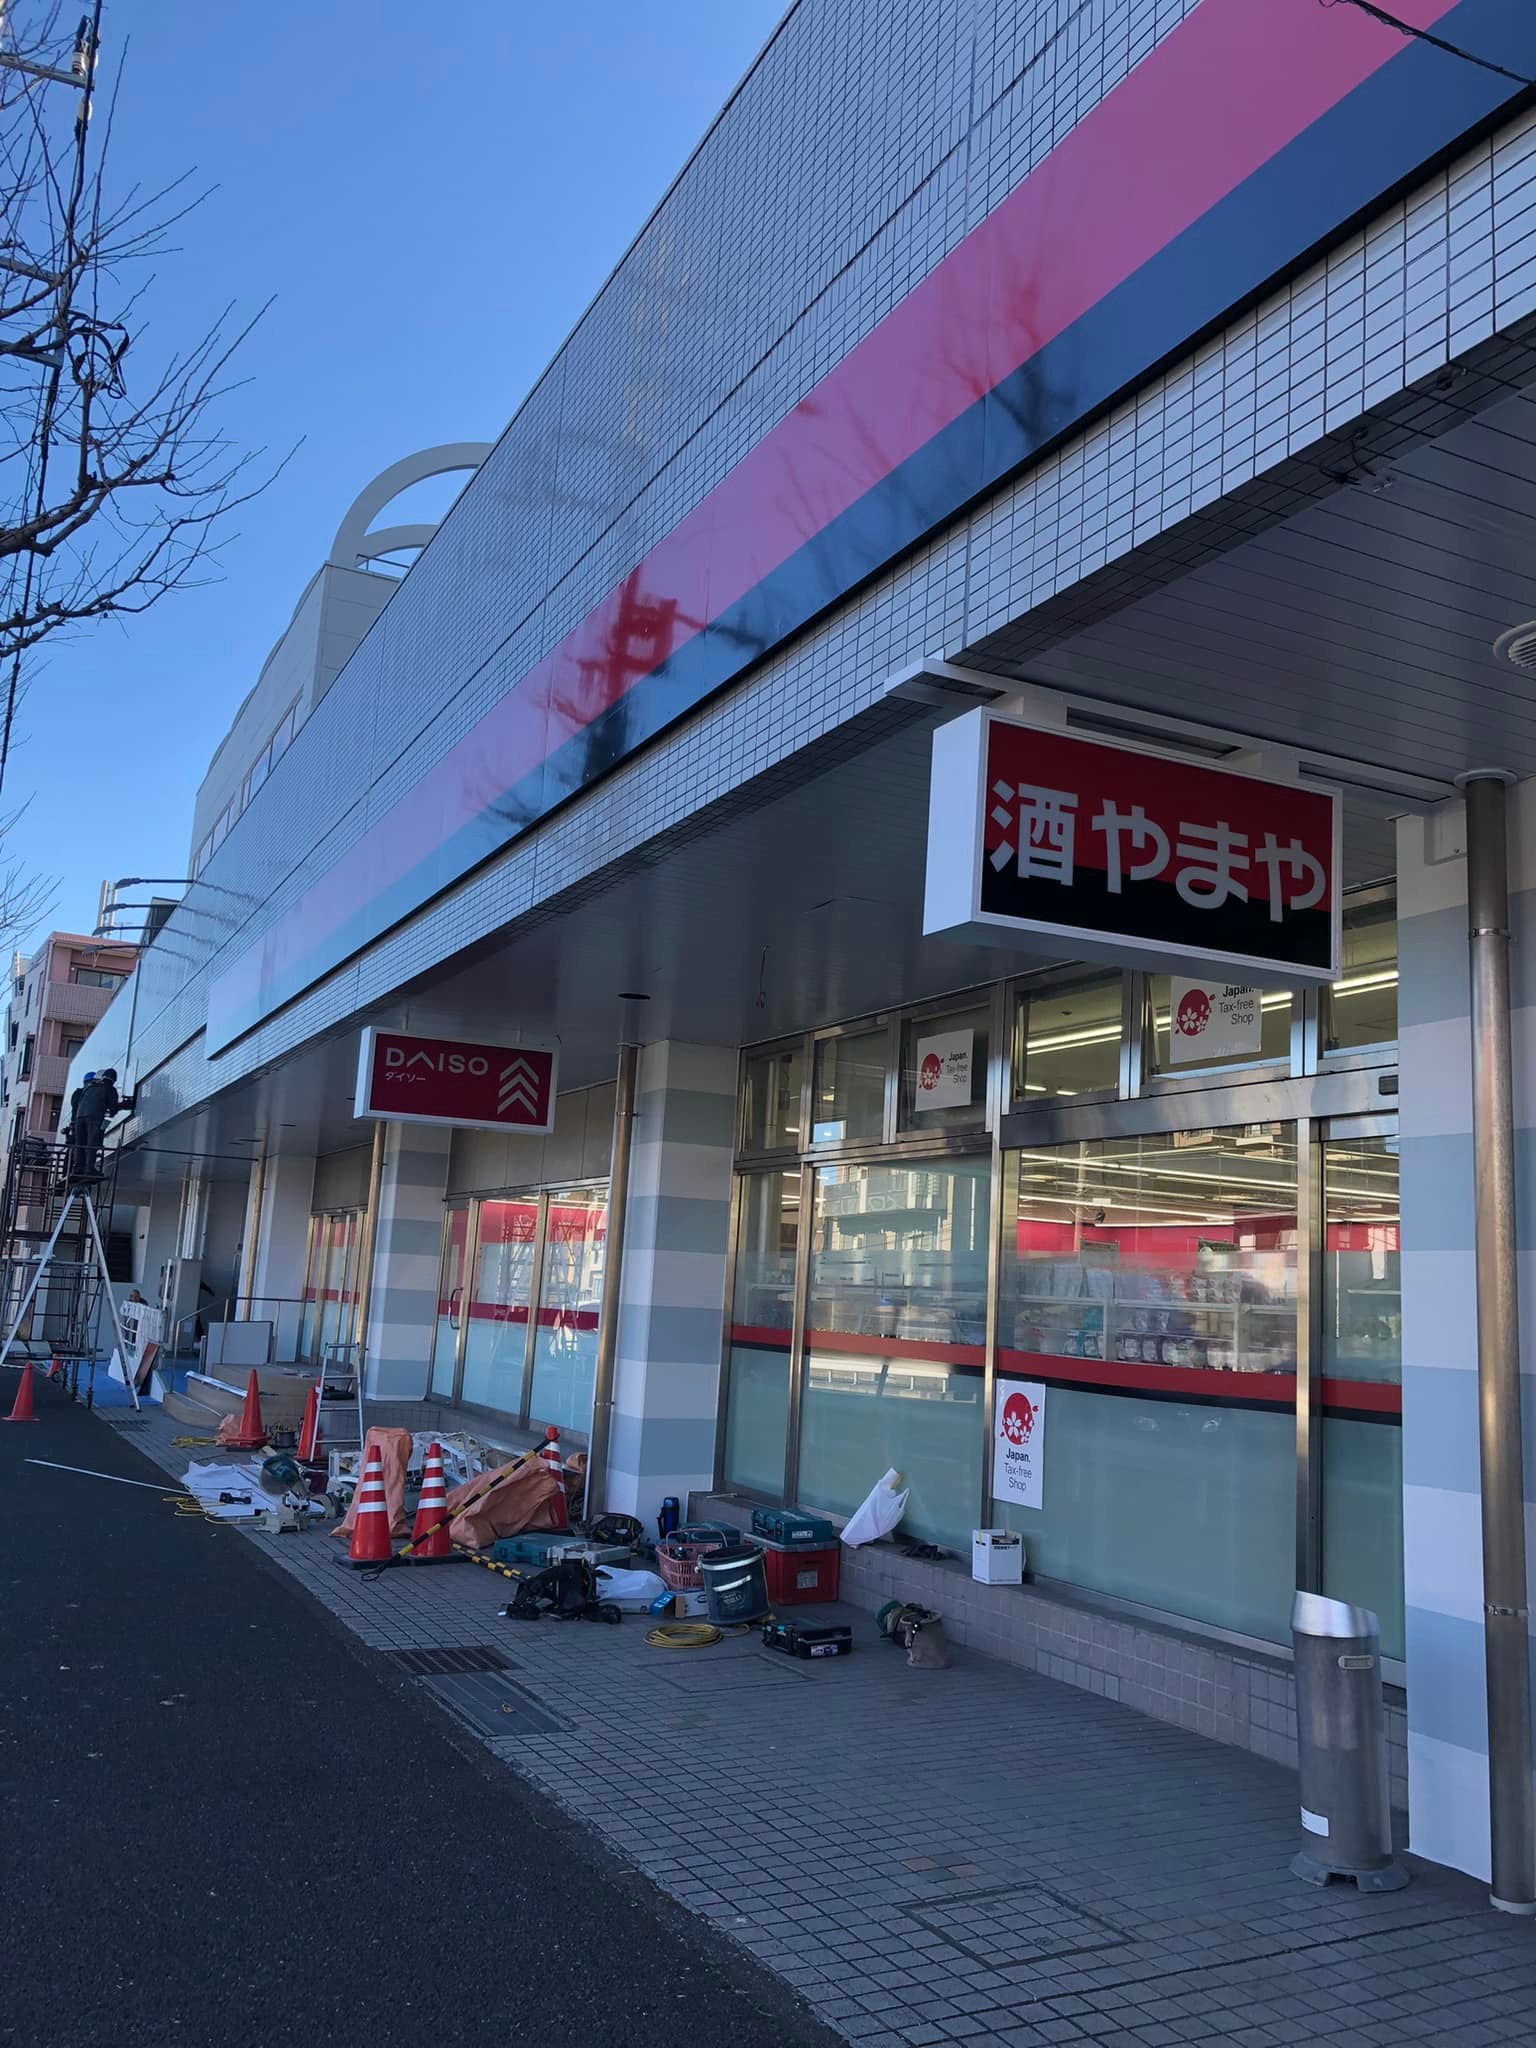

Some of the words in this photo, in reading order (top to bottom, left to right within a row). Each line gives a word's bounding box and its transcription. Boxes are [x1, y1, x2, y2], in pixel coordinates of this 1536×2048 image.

[1219, 999, 1254, 1013] Tax-free
[1231, 1013, 1254, 1025] Shop
[385, 1047, 489, 1076] DAISO
[384, 1070, 427, 1083] ダイソー
[1003, 1462, 1032, 1479] Tax-free
[1008, 1476, 1027, 1492] Shop
